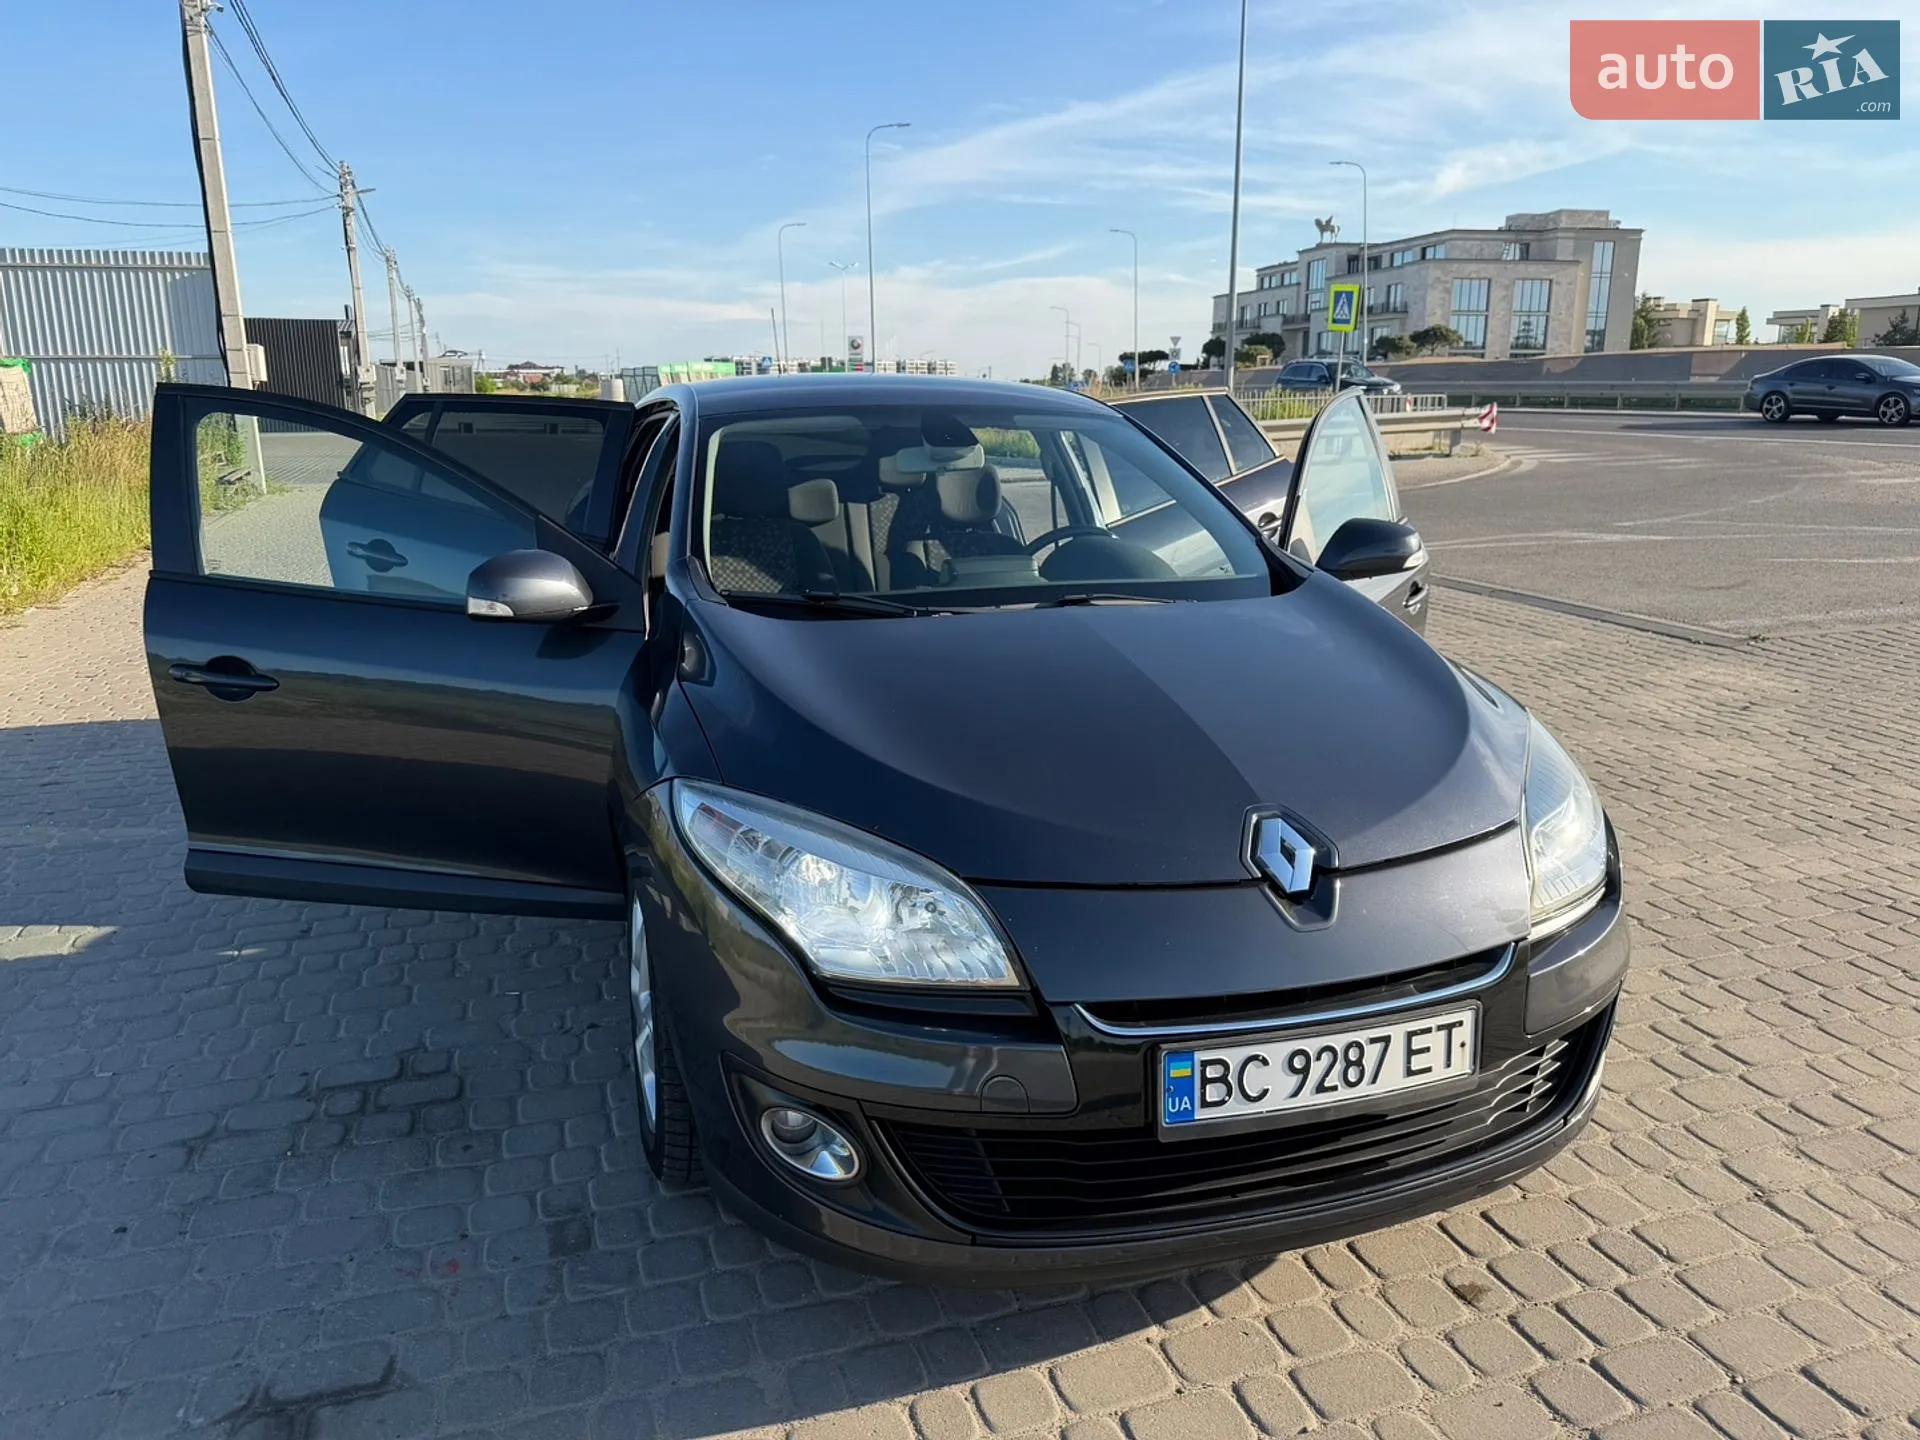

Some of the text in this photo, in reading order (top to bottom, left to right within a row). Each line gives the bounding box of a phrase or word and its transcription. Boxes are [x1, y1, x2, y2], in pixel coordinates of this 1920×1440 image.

[1200, 1020, 1464, 1109] BC 9287 ET
[1168, 1095, 1192, 1113] UA
